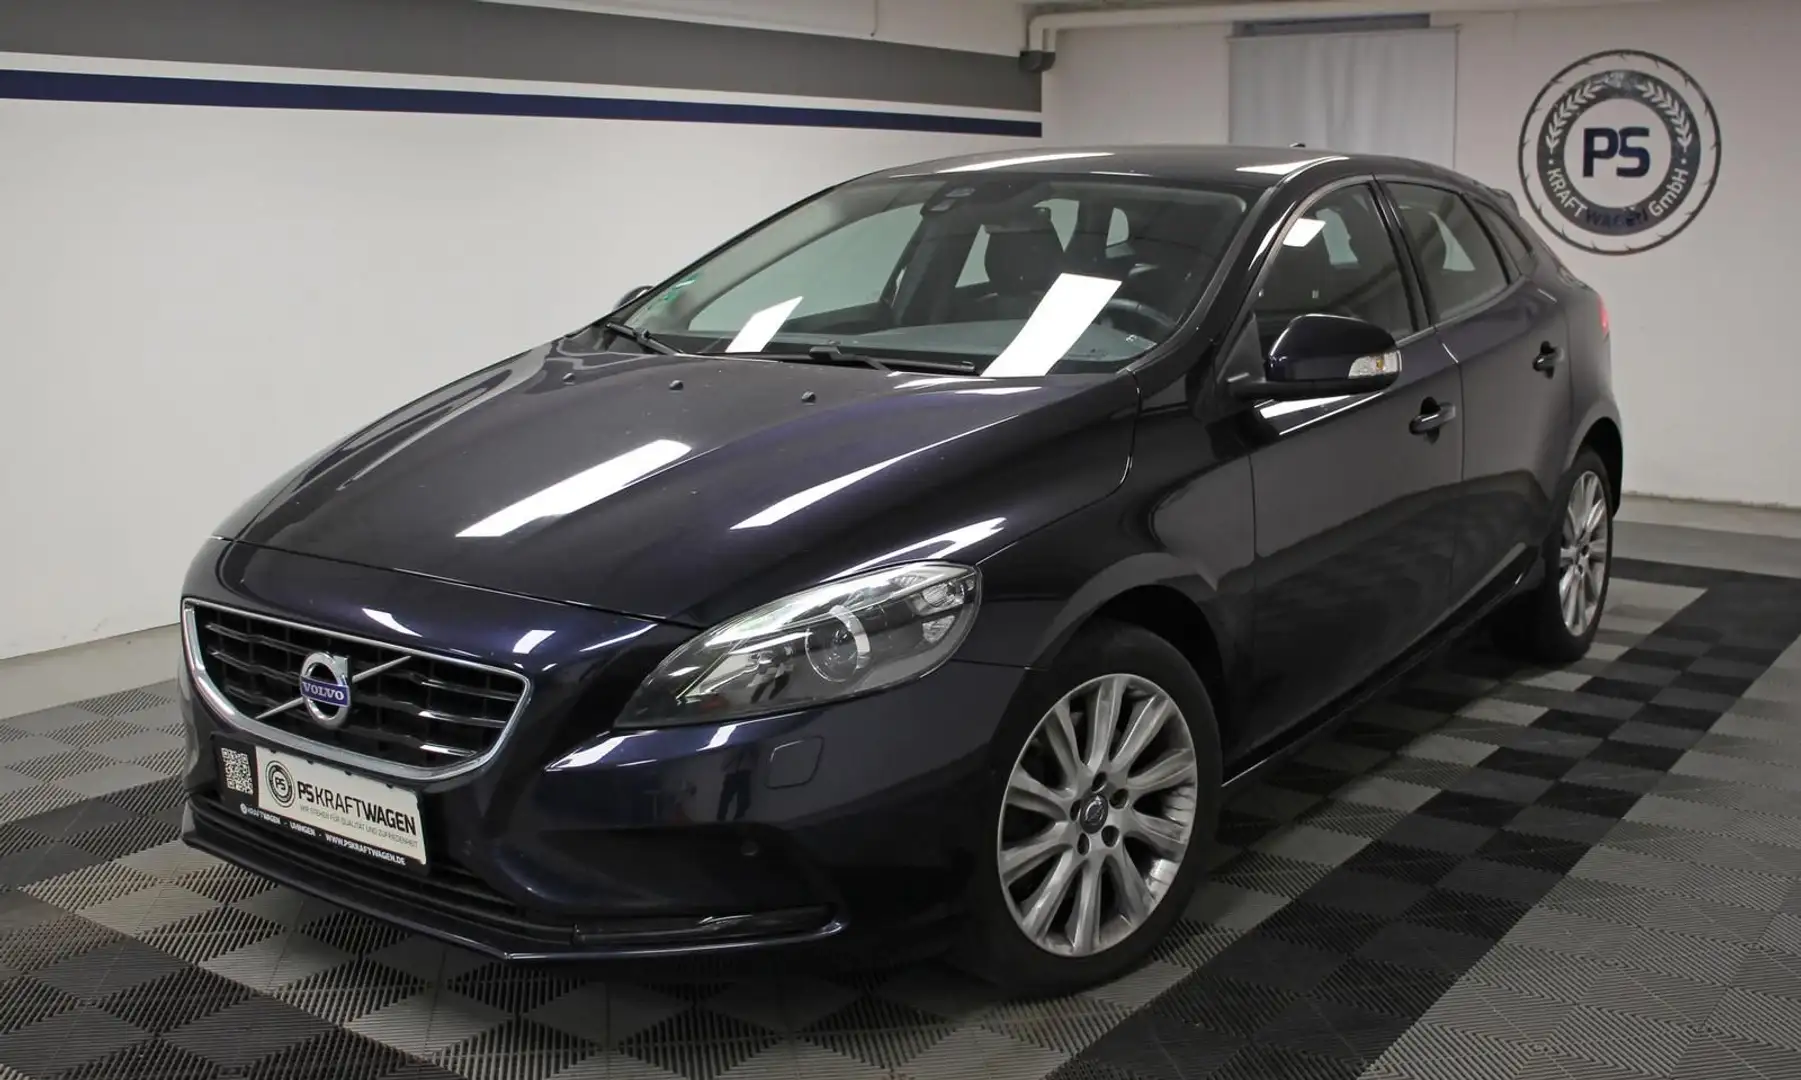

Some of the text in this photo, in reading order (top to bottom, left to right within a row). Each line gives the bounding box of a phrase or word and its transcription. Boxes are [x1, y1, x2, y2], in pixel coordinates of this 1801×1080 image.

[1582, 126, 1650, 178] PS
[1648, 167, 1689, 217] GmbH
[301, 681, 345, 701] VOLVO
